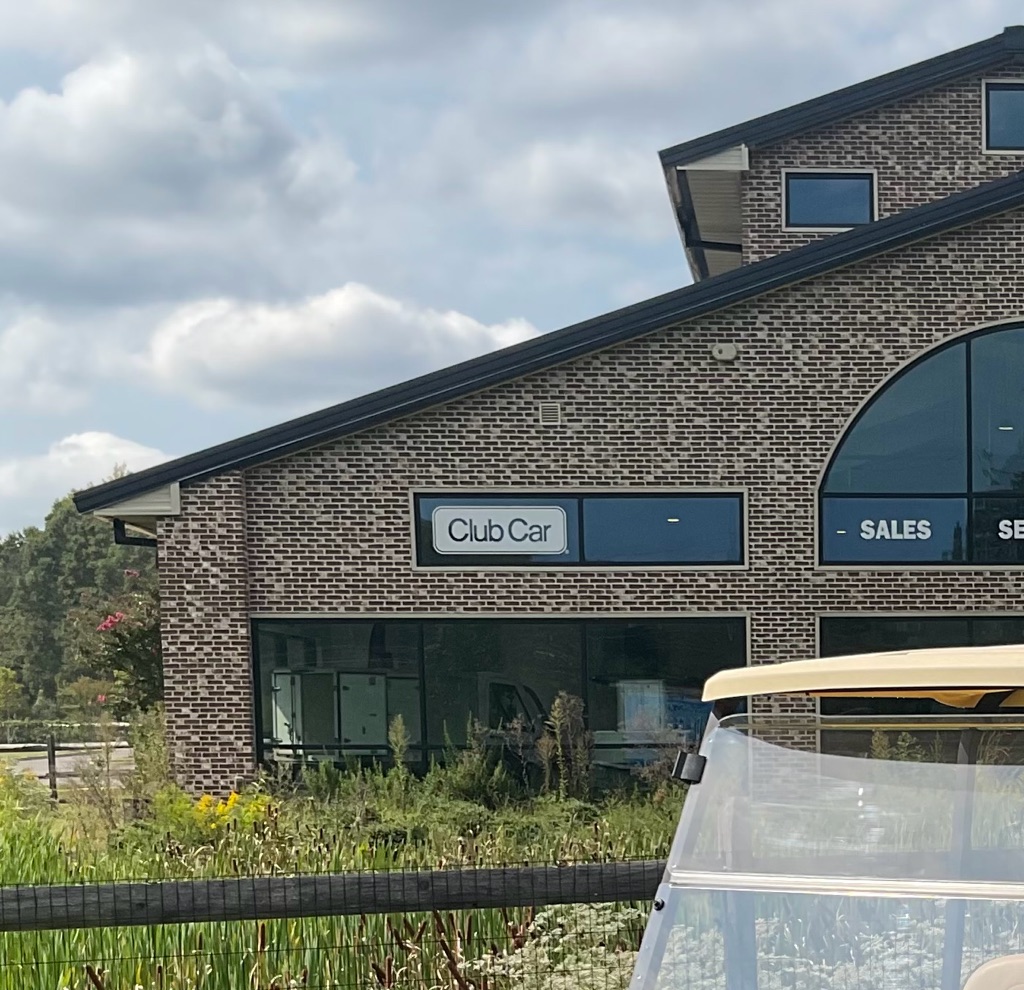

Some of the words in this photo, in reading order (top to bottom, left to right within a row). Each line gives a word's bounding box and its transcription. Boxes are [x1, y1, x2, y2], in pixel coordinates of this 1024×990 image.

[448, 518, 504, 543] Club
[508, 518, 552, 543] Car
[860, 519, 932, 540] SALES
